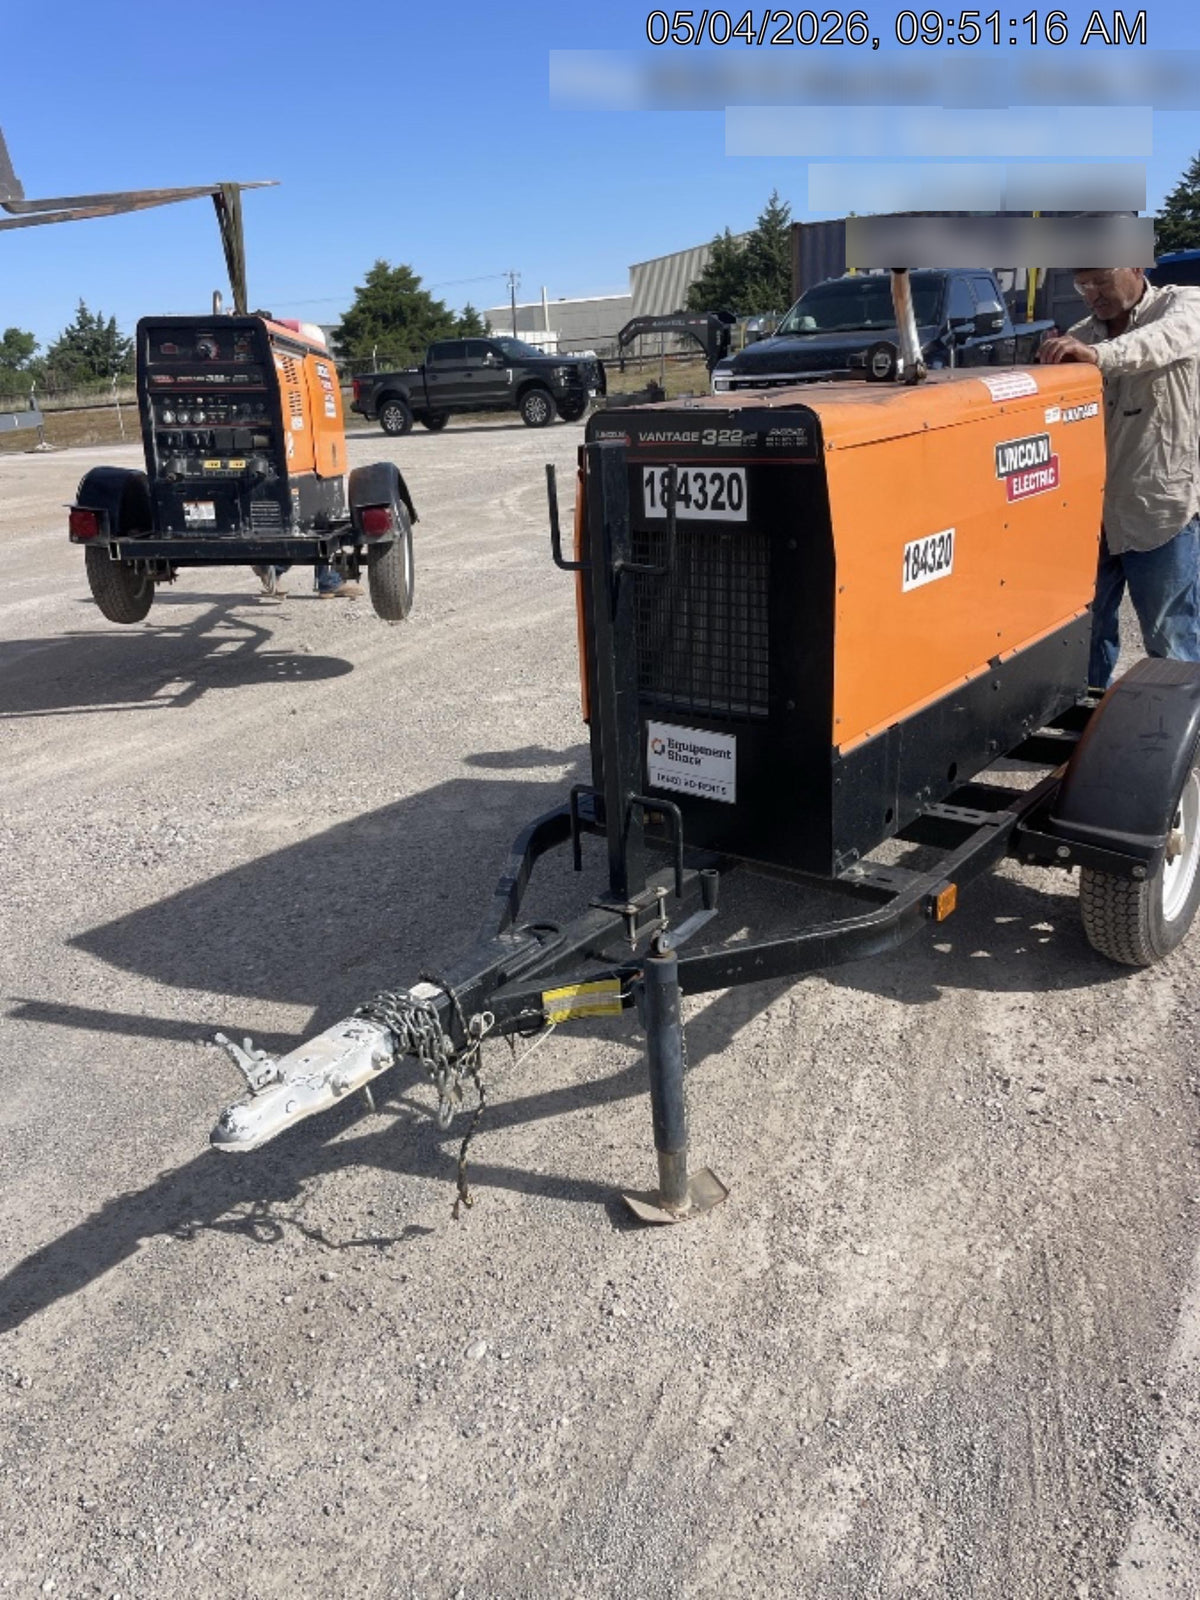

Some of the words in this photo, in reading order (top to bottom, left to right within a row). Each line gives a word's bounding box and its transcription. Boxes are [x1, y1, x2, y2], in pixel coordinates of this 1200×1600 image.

[639, 431, 700, 442] VANTAGE
[702, 428, 743, 446] 322
[998, 439, 1048, 474] LINCOLN
[1013, 467, 1056, 496] ELECTRIC
[904, 532, 952, 582] 184320
[667, 738, 732, 760] Equipment
